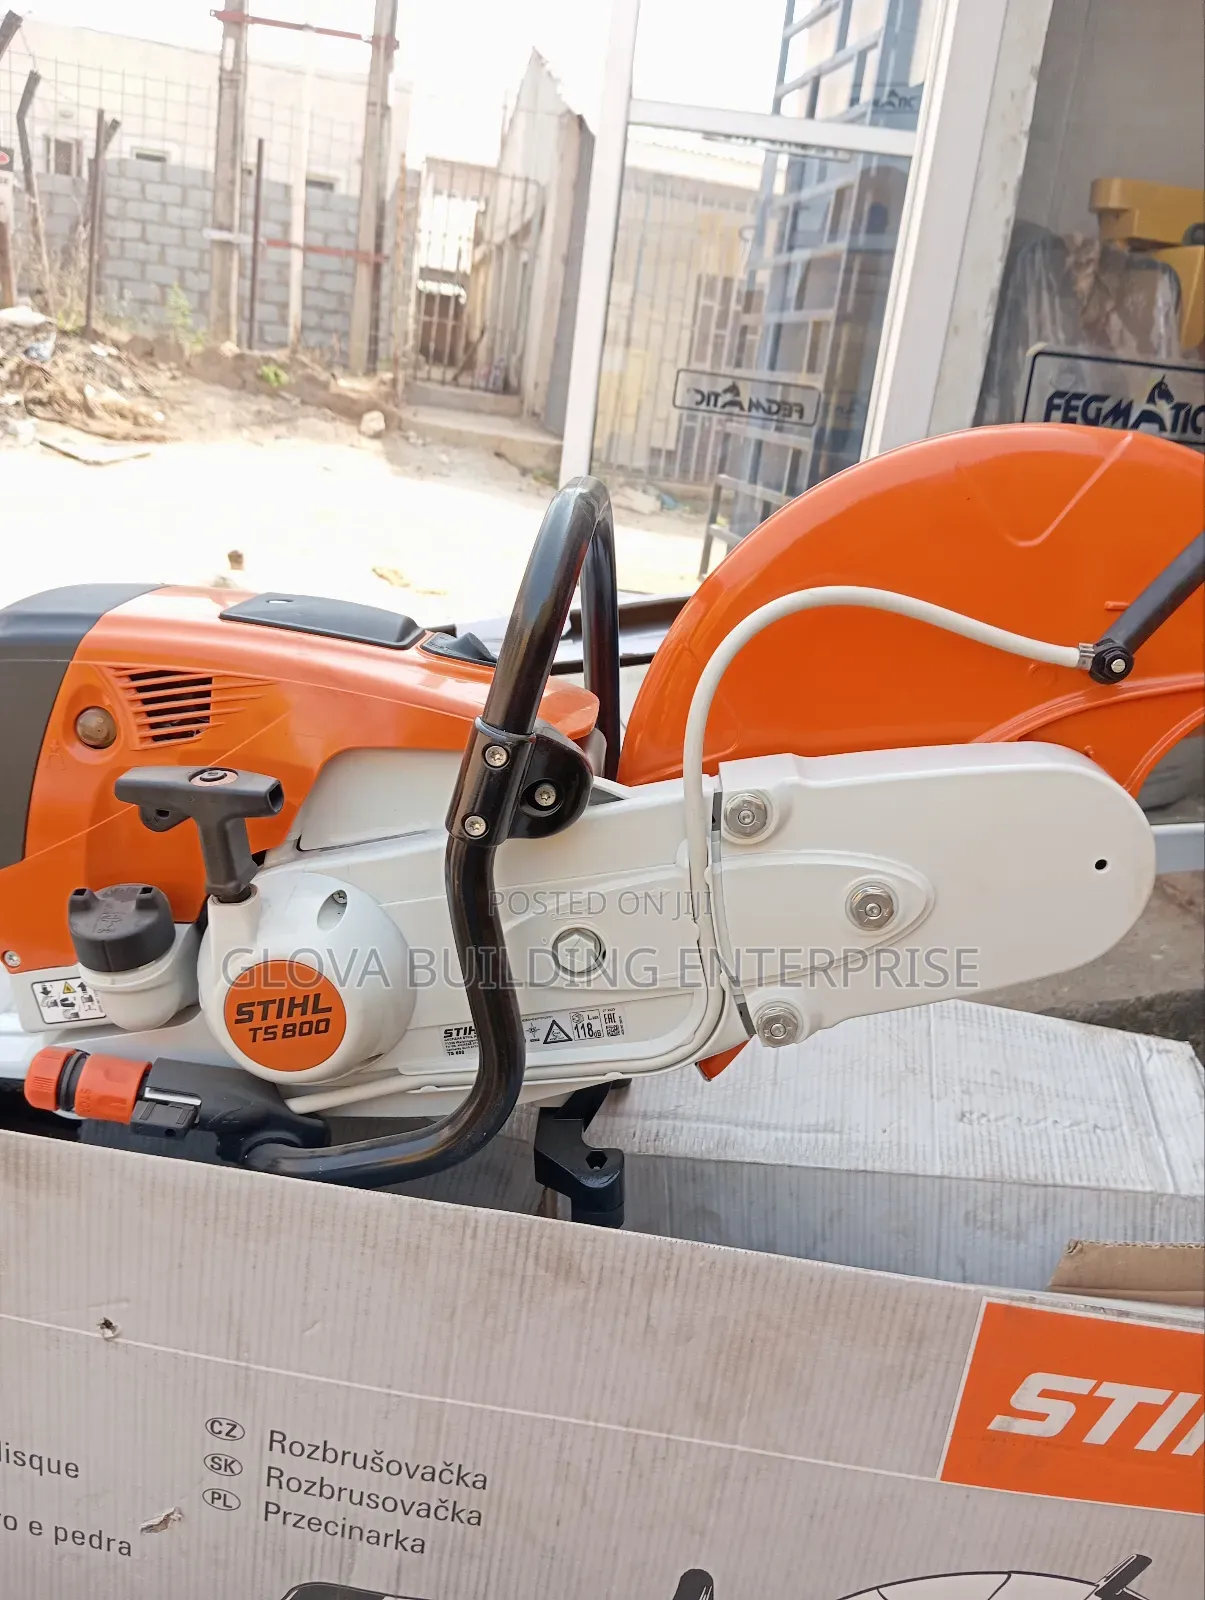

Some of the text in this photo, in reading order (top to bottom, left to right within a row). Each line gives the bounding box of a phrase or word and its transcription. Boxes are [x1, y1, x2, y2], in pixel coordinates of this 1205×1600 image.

[1043, 374, 1204, 434] FEGMATIC
[234, 993, 332, 1024] STIHL
[209, 1419, 488, 1491] CZ Rozbrušovačka
[209, 1455, 482, 1526] SK Rozbrusovačka
[0, 1512, 132, 1557] o e pedra
[210, 1491, 426, 1554] PL Przecinarka
